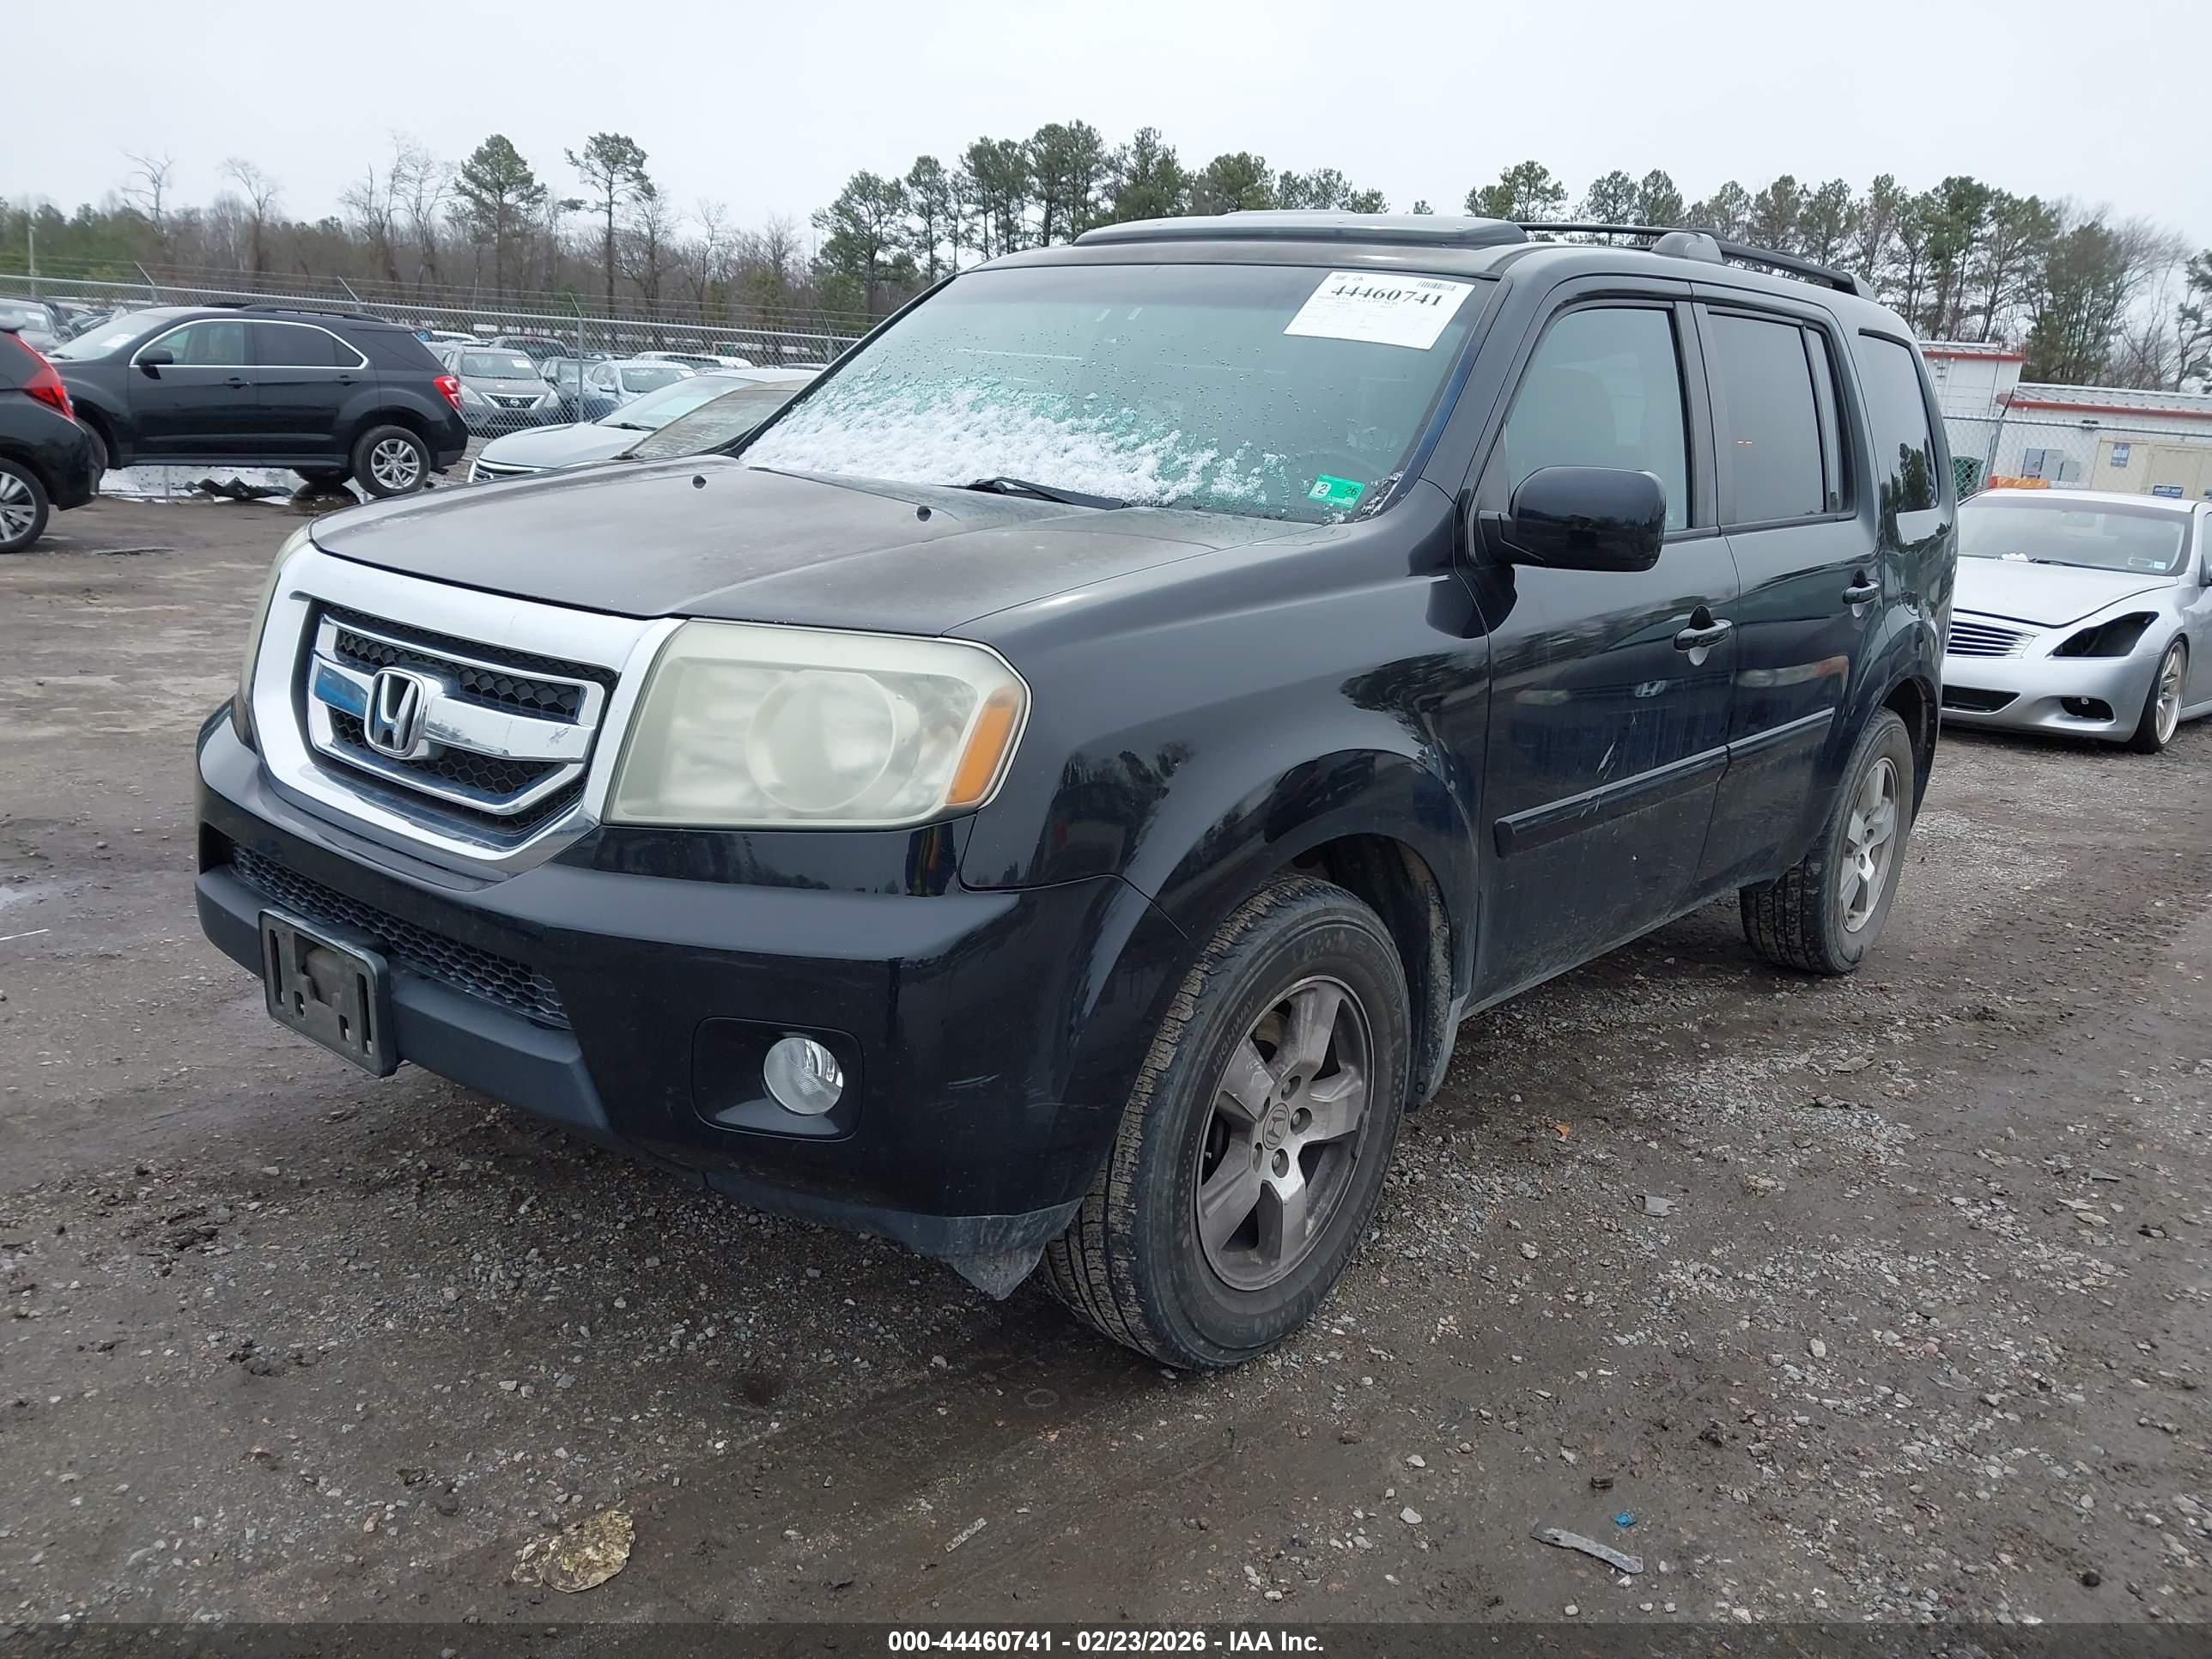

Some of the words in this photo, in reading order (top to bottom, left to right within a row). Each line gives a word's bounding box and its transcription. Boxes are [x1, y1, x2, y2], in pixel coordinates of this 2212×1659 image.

[1331, 284, 1443, 307] 44460741
[1317, 483, 1328, 495] 2
[1212, 995, 1255, 1074] HIGHWAY
